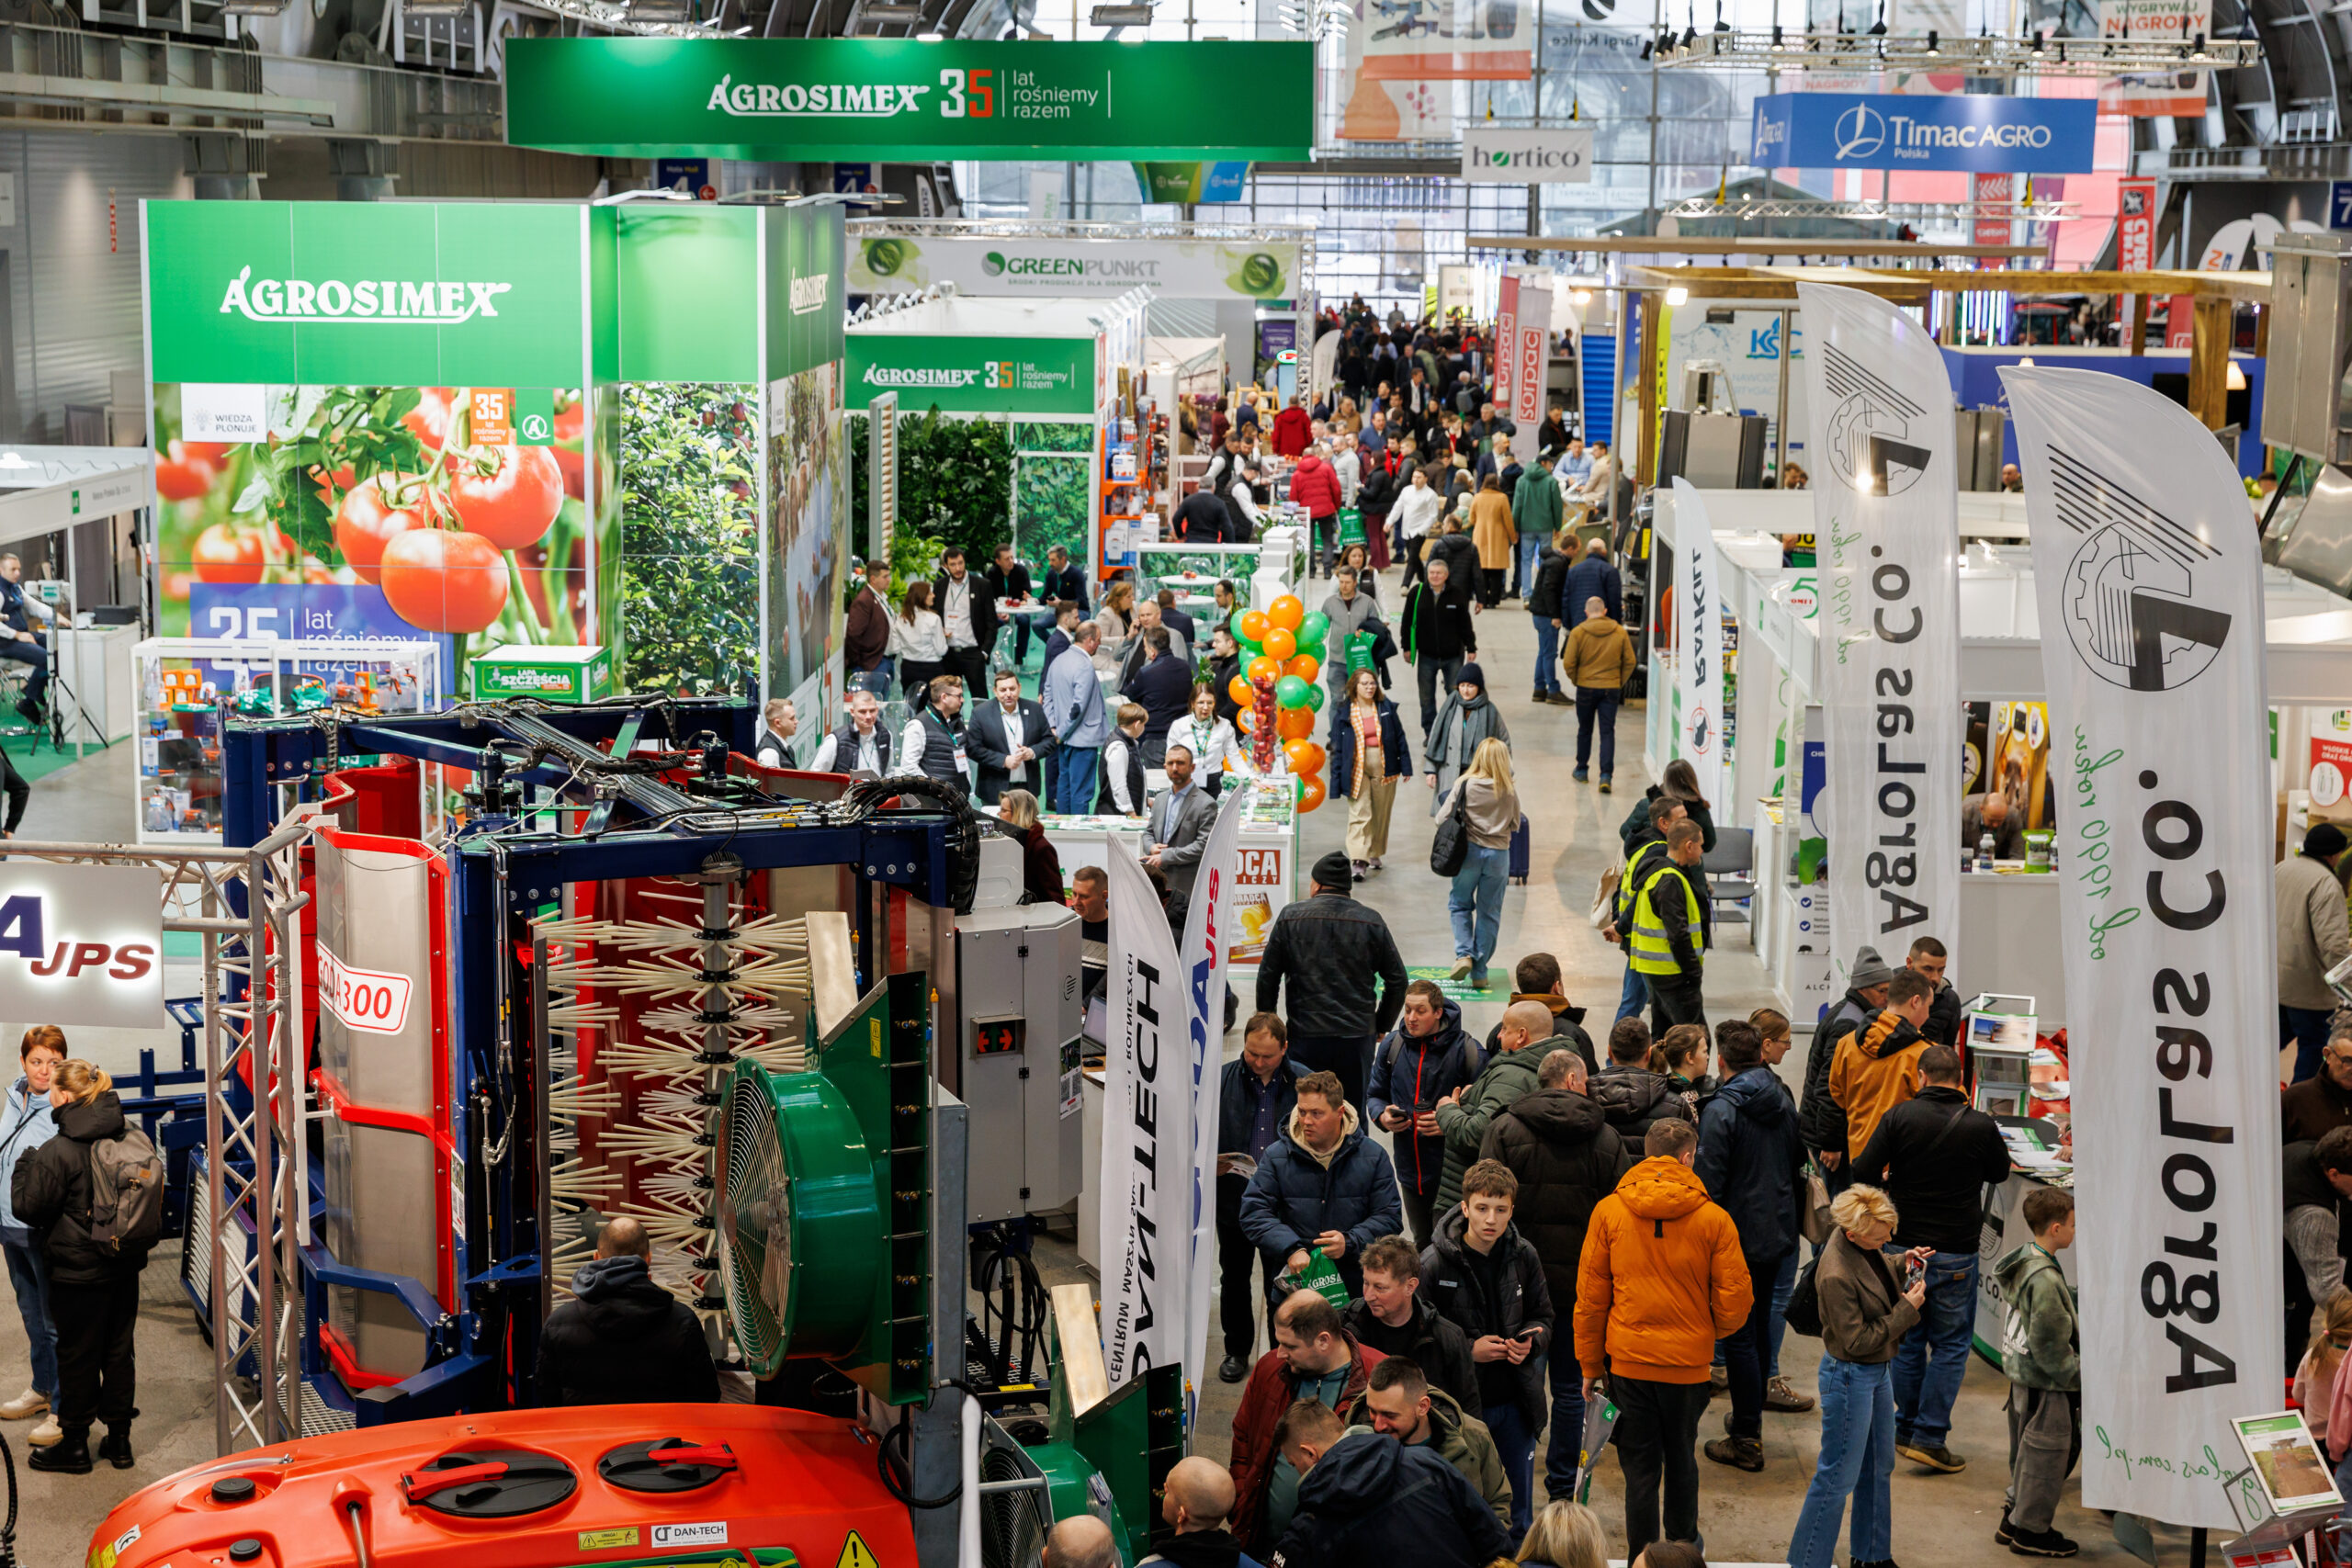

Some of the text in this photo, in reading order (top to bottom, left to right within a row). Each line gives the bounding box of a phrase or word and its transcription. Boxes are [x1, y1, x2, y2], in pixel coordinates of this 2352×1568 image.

[2107, 14, 2206, 31] NAGRODY
[1013, 70, 1035, 86] lat
[707, 69, 993, 118] AGROSIMEX 35
[1013, 85, 1099, 107] rośniemy
[1013, 104, 1070, 119] razem
[1473, 145, 1580, 167] hortico
[1894, 148, 1929, 159] Polska
[220, 265, 512, 323] AGROSIMEX
[789, 267, 829, 315] AGROSIMEX
[863, 361, 1013, 389] AGROSIMEX 35
[1023, 363, 1035, 372] lat
[1023, 369, 1068, 383] rośniemy
[1521, 332, 1540, 420] sorpac
[1023, 380, 1053, 389] razem
[475, 393, 503, 420] 35
[215, 414, 253, 423] WIEDZA
[215, 423, 257, 434] PLONUJE
[306, 607, 334, 630] lat
[501, 672, 571, 687] SZCZĘŚCIA
[30, 942, 154, 980] JPS
[343, 980, 391, 1020] 300
[674, 1525, 724, 1537] DAN-TECH
